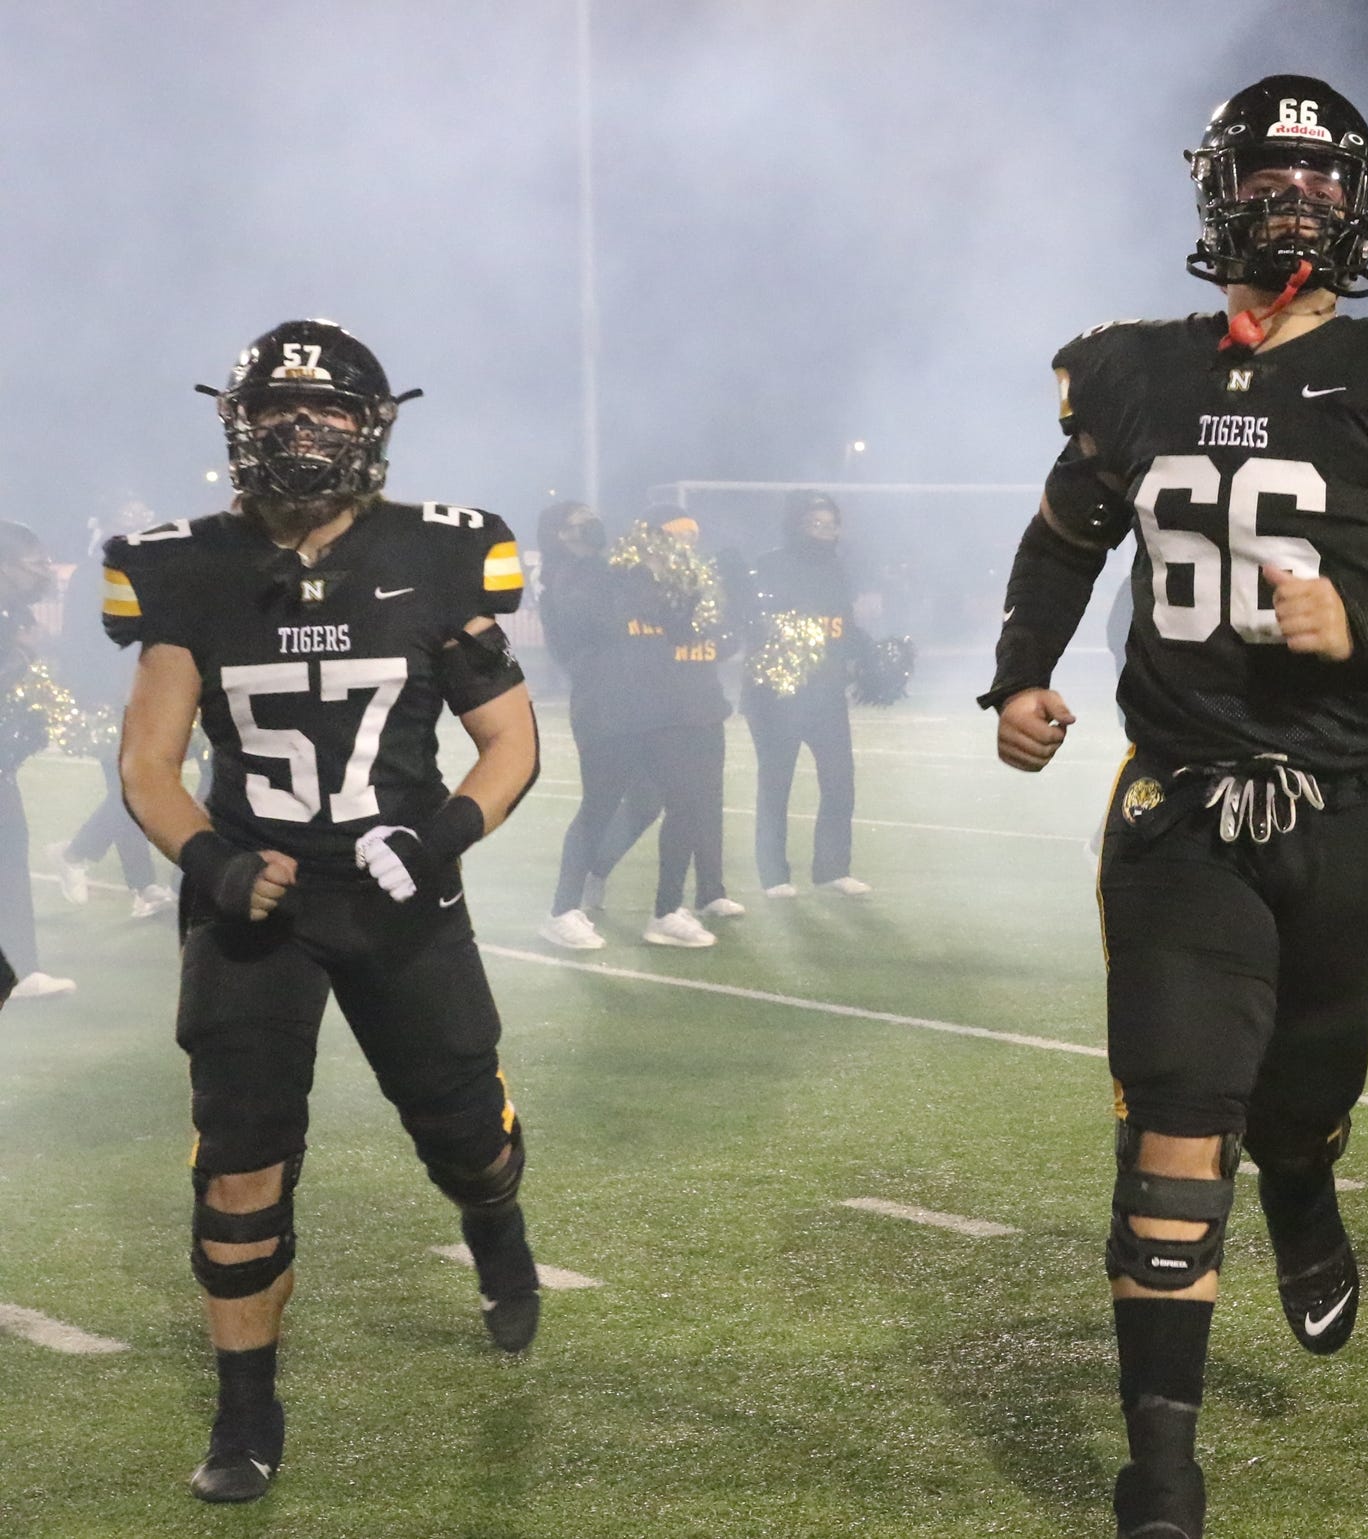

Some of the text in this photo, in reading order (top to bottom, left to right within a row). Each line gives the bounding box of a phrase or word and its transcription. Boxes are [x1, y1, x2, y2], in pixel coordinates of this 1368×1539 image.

[1279, 97, 1319, 125] 66
[1276, 124, 1325, 138] Riddell
[282, 342, 322, 368] 57
[1227, 368, 1254, 392] N
[1198, 414, 1269, 449] TIGERS
[1134, 454, 1327, 644] 66
[301, 579, 325, 602] N
[277, 623, 351, 654] TIGERS
[220, 656, 408, 824] 57
